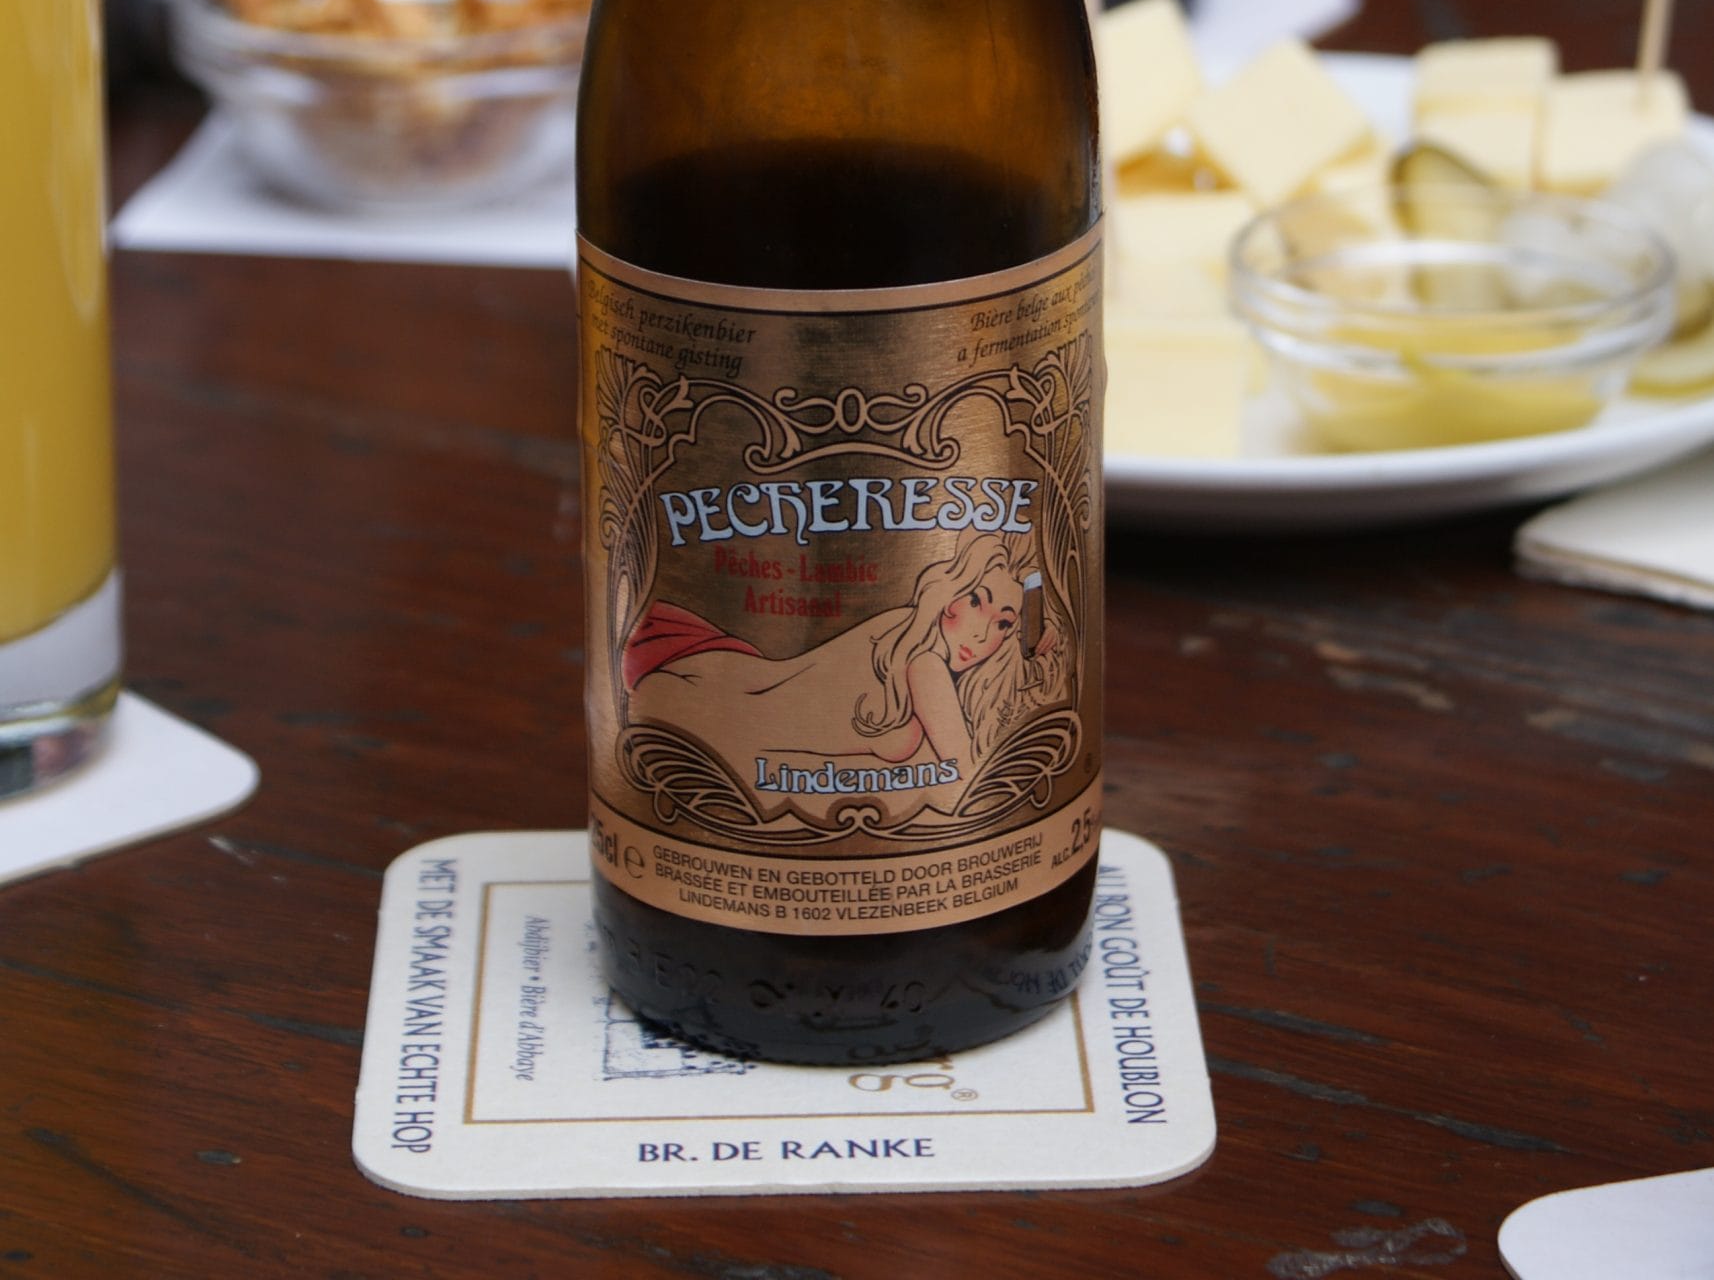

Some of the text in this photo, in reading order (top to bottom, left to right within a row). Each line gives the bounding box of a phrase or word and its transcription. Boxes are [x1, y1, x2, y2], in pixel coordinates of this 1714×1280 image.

[638, 310, 757, 344] perzikenbier
[970, 308, 1013, 331] Bière
[1016, 294, 1049, 323] belge
[610, 325, 674, 359] spontane
[674, 344, 744, 378] gisting
[969, 318, 1063, 368] fermentation
[659, 477, 1039, 547] PECHERESSE
[743, 585, 842, 618] Artisanal
[755, 757, 960, 794] Lindemans
[653, 832, 1043, 886] GEBROUWEN EN GEBOTTELD DOOR BROUWERIJ
[655, 850, 1042, 902] BRASSÉE ET EMBOUTEILLÉE PAR LA BRASSERIE
[679, 877, 1019, 920] LINDEMANS B 1602 VLEZENBEEK BELGIUM
[1095, 894, 1135, 931] BON
[517, 915, 553, 973] Abdijbier
[391, 858, 458, 1154] MET DE SMAAK VAN ECHTE HOP
[518, 985, 547, 1017] Bière
[1109, 997, 1149, 1019] DE
[1113, 1026, 1167, 1124] HOUBLON
[638, 1138, 935, 1162] BR. DE RANKE
